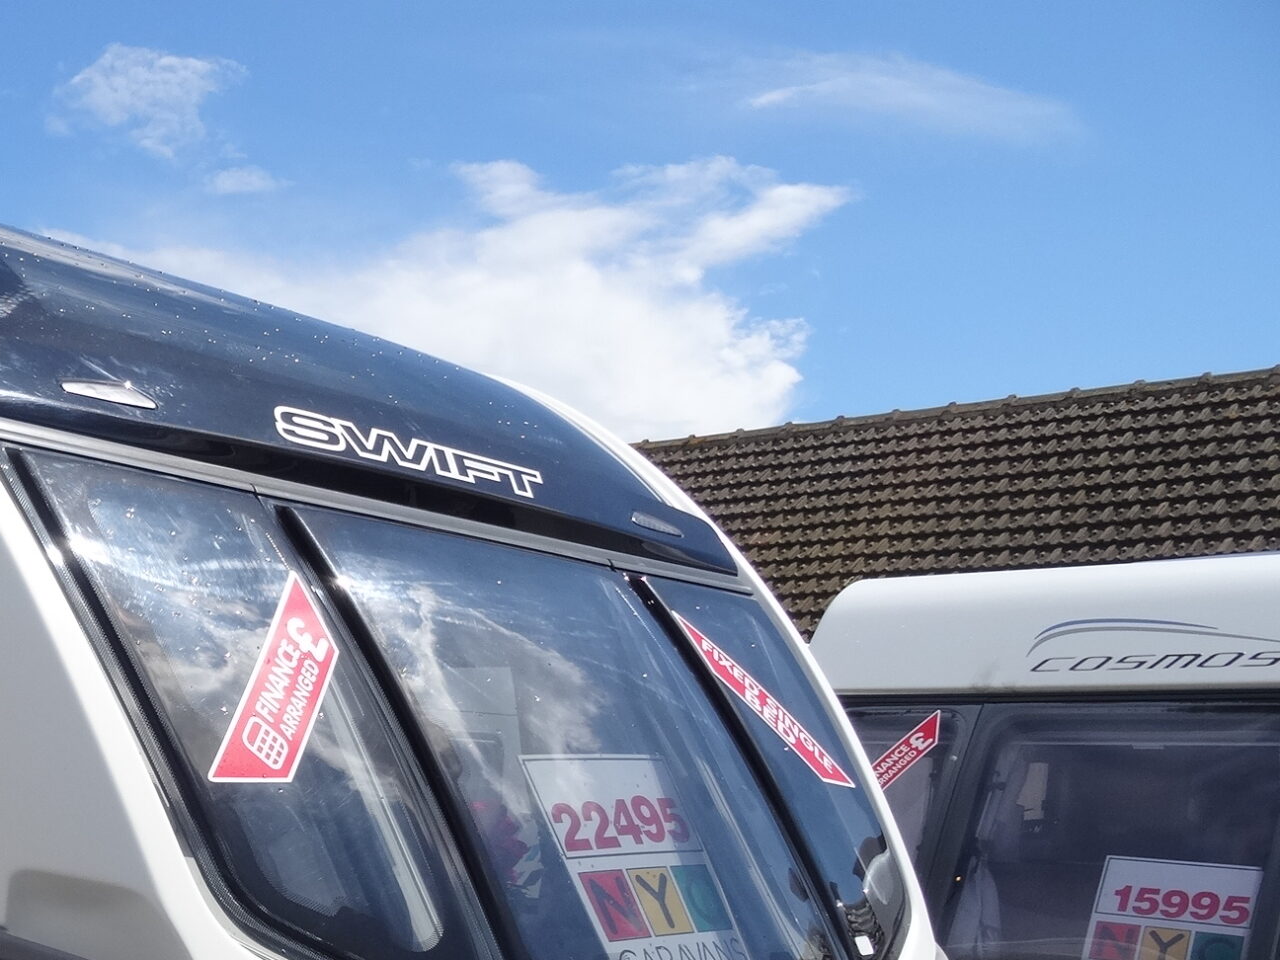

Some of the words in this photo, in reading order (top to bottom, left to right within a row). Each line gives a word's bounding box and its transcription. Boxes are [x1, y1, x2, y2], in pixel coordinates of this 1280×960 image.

[273, 405, 544, 498] SWIFT
[255, 639, 301, 723] FINANCE
[1030, 651, 1280, 672] COSMOS
[279, 659, 320, 741] ARRANGED
[700, 638, 761, 696] FIXED
[762, 697, 835, 774] SINGLE
[744, 687, 797, 745] BED
[874, 744, 911, 777] NANCE
[879, 750, 917, 785] RRANGED
[551, 795, 690, 852] 22495
[1114, 885, 1251, 925] 15995
